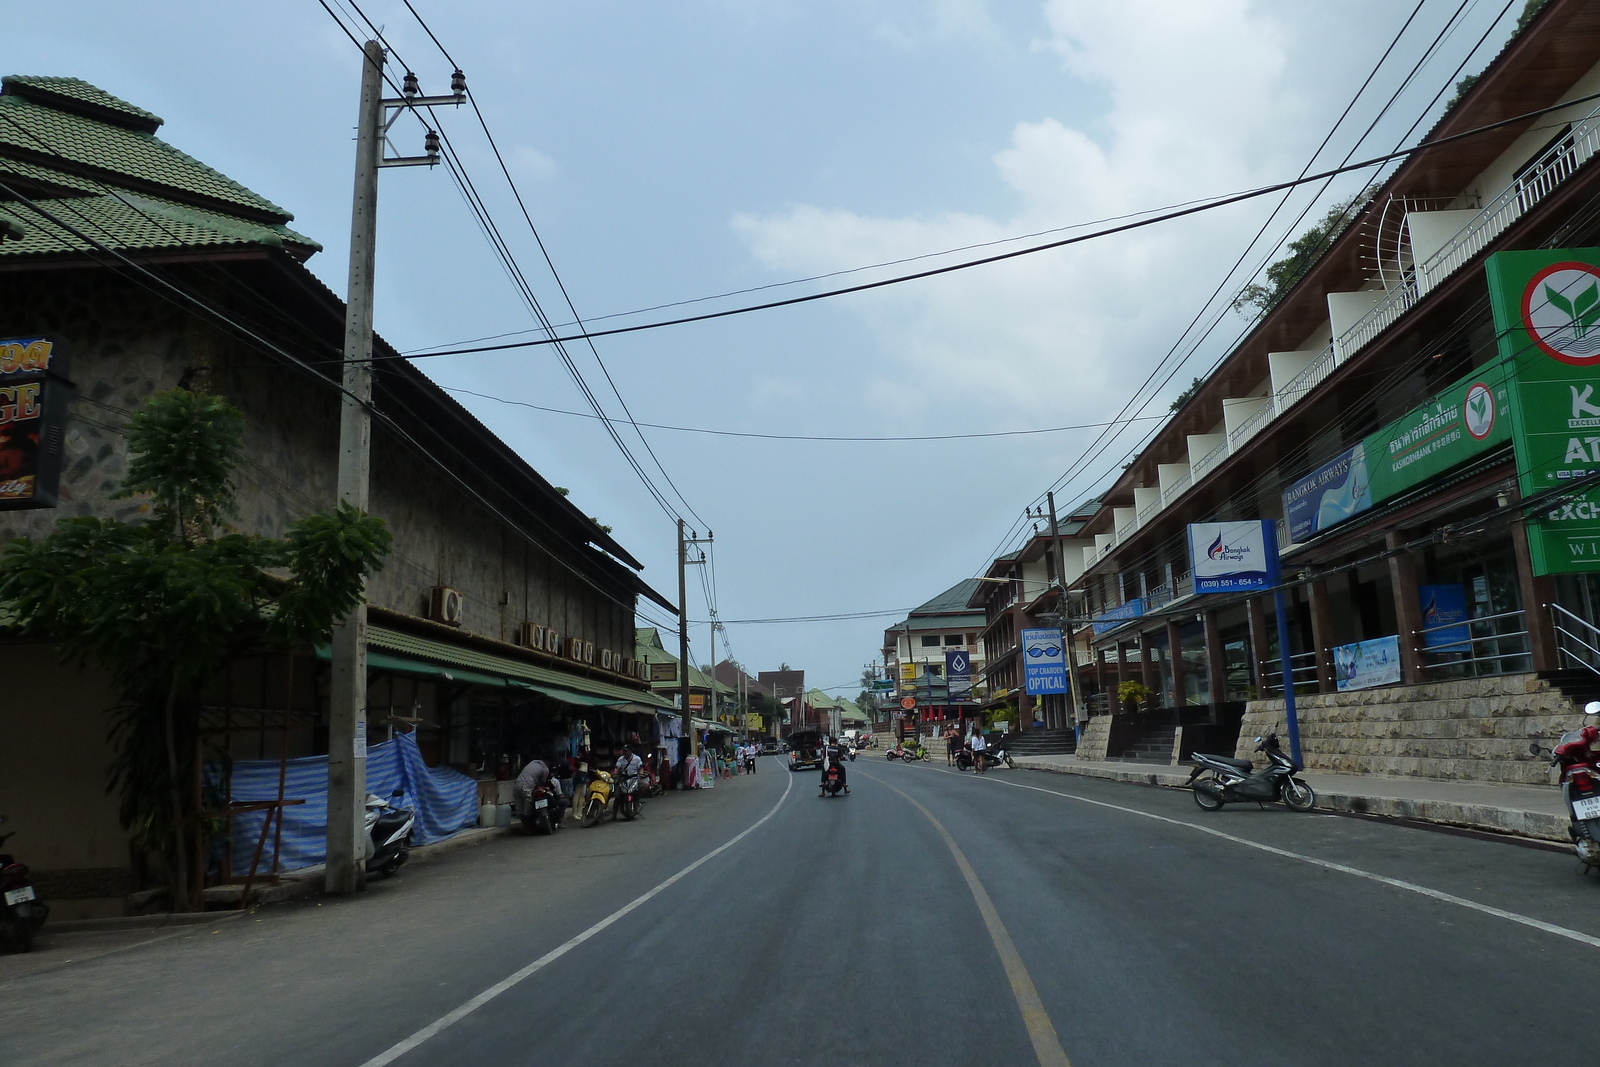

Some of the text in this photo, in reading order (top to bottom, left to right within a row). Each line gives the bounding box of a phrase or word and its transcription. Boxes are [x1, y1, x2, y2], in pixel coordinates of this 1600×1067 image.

[1391, 443, 1432, 473] KASIKORNBANK
[1286, 459, 1348, 504] BANGKOK AIRWAYS
[1224, 545, 1251, 555] Bangkok
[1219, 552, 1244, 562] Airways
[1200, 580, 1219, 589] (039)
[1027, 666, 1064, 676] TOP CHAROEN
[1028, 676, 1065, 690] OPTICAL
